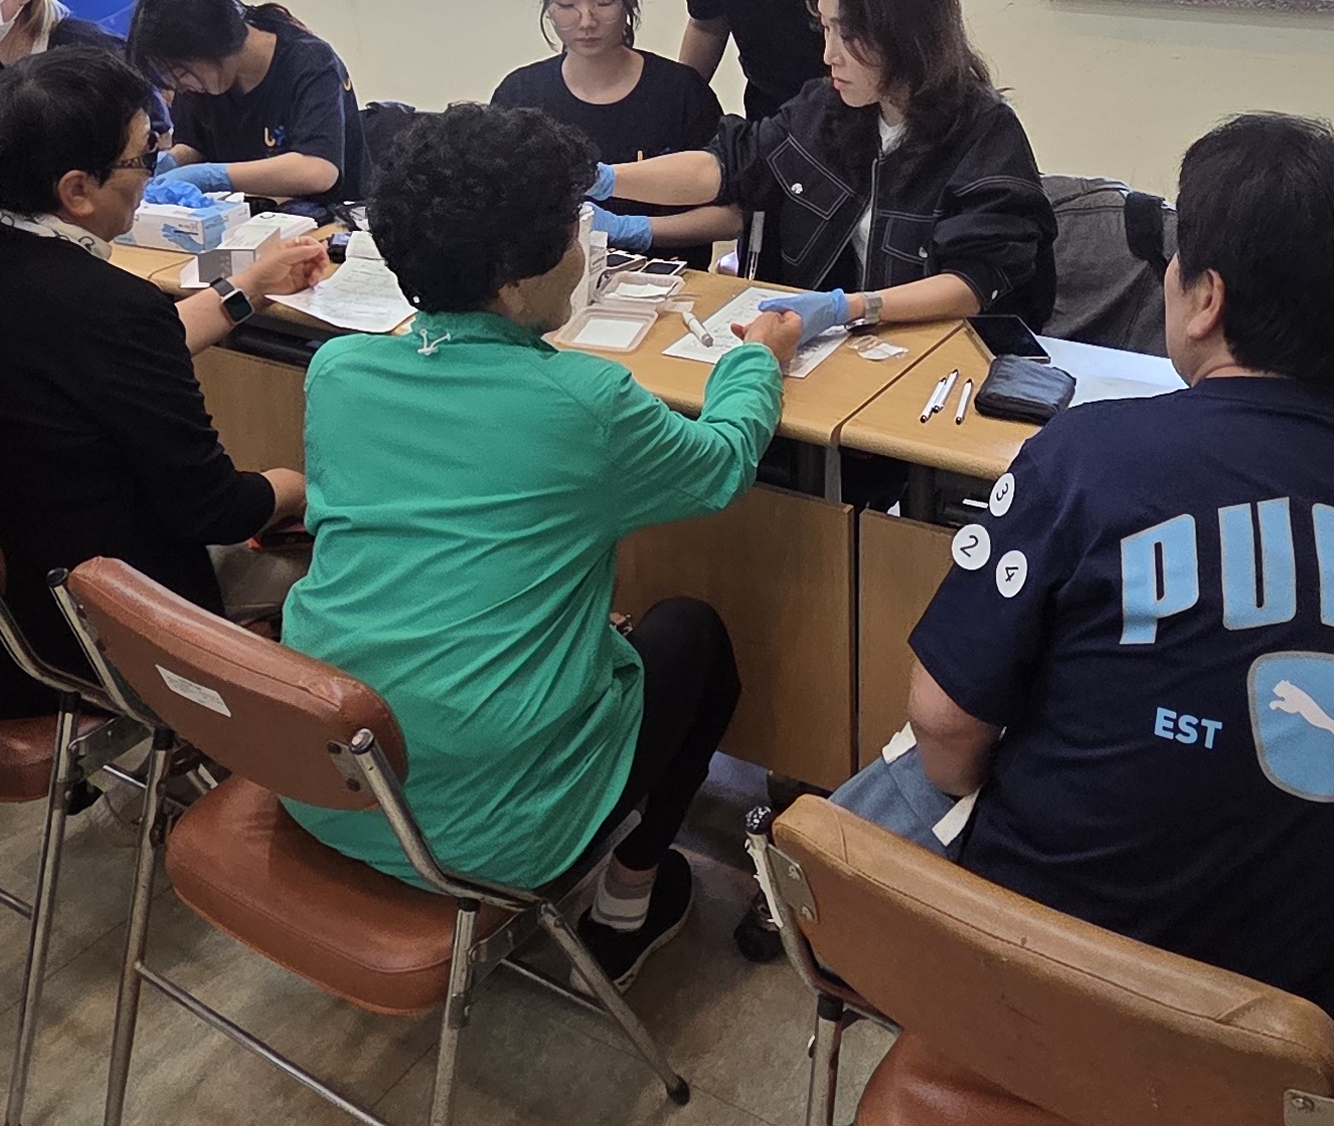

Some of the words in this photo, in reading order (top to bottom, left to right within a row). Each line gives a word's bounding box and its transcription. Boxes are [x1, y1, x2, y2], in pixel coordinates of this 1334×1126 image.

[996, 483, 1009, 501] 3
[960, 535, 979, 558] 2
[1005, 566, 1019, 582] 4
[1154, 706, 1223, 750] EST
